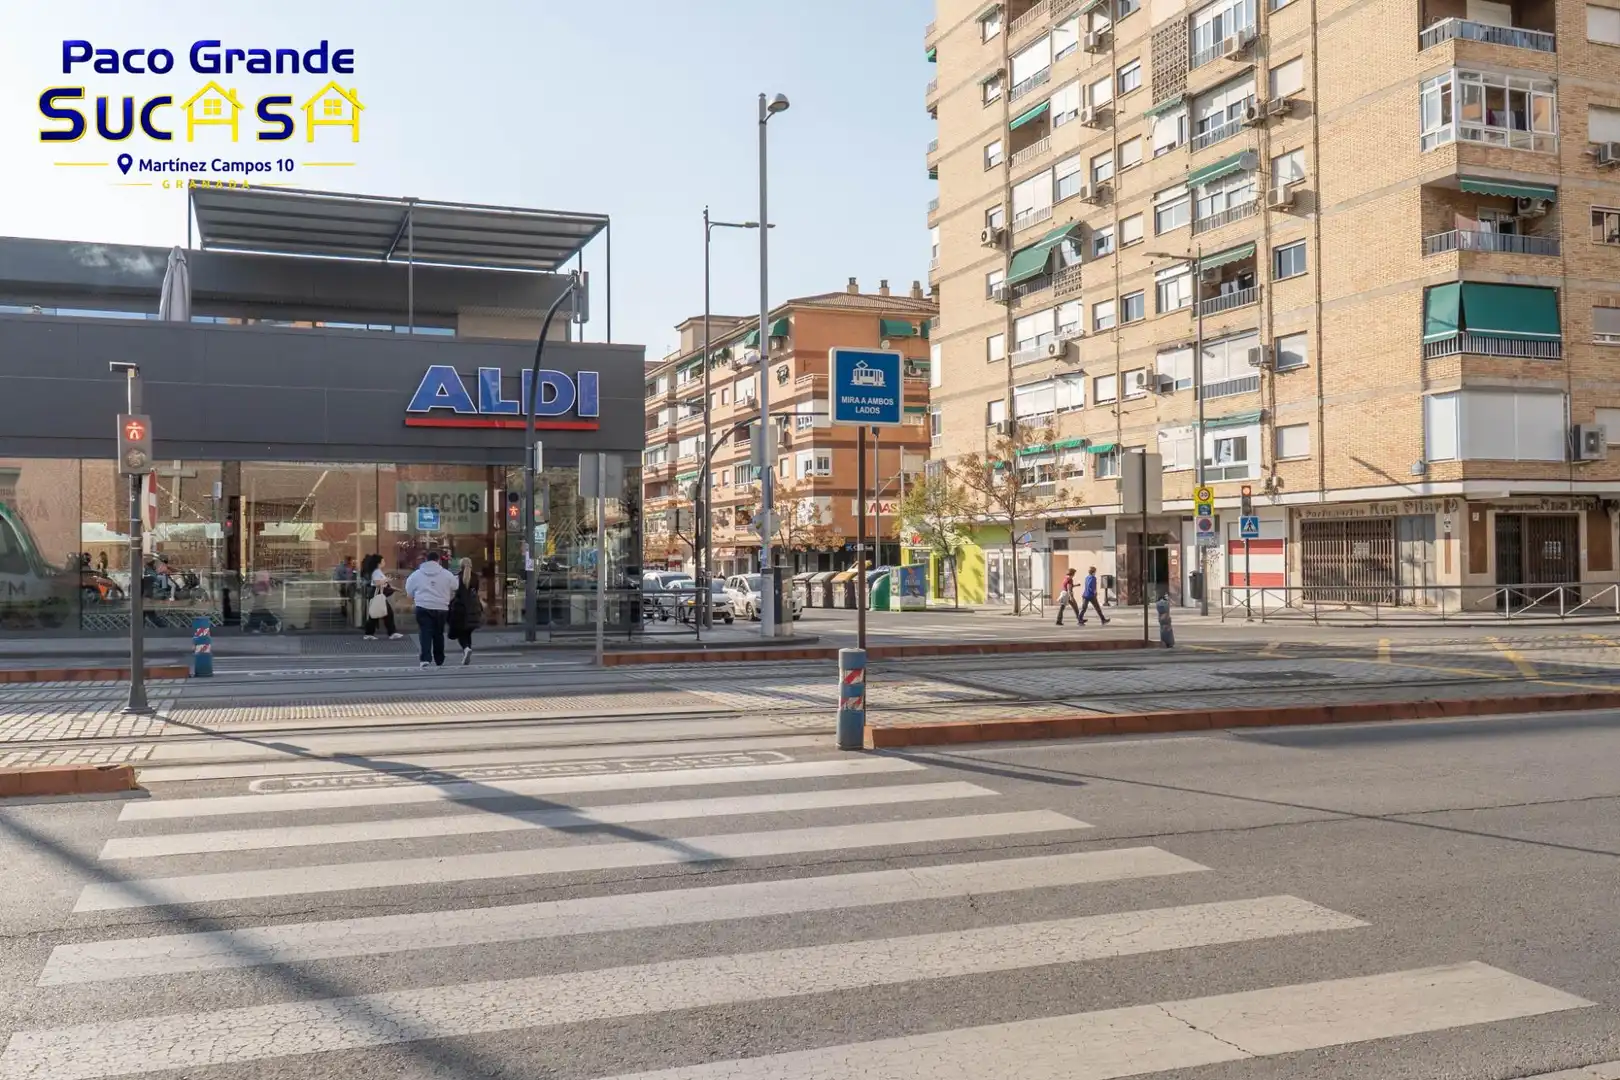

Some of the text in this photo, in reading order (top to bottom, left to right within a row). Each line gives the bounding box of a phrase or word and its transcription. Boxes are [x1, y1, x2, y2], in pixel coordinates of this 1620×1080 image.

[406, 364, 600, 418] ALDI
[841, 395, 894, 406] MIRA A AMBOS
[855, 406, 881, 415] LADOS
[406, 492, 480, 514] PRECIOS
